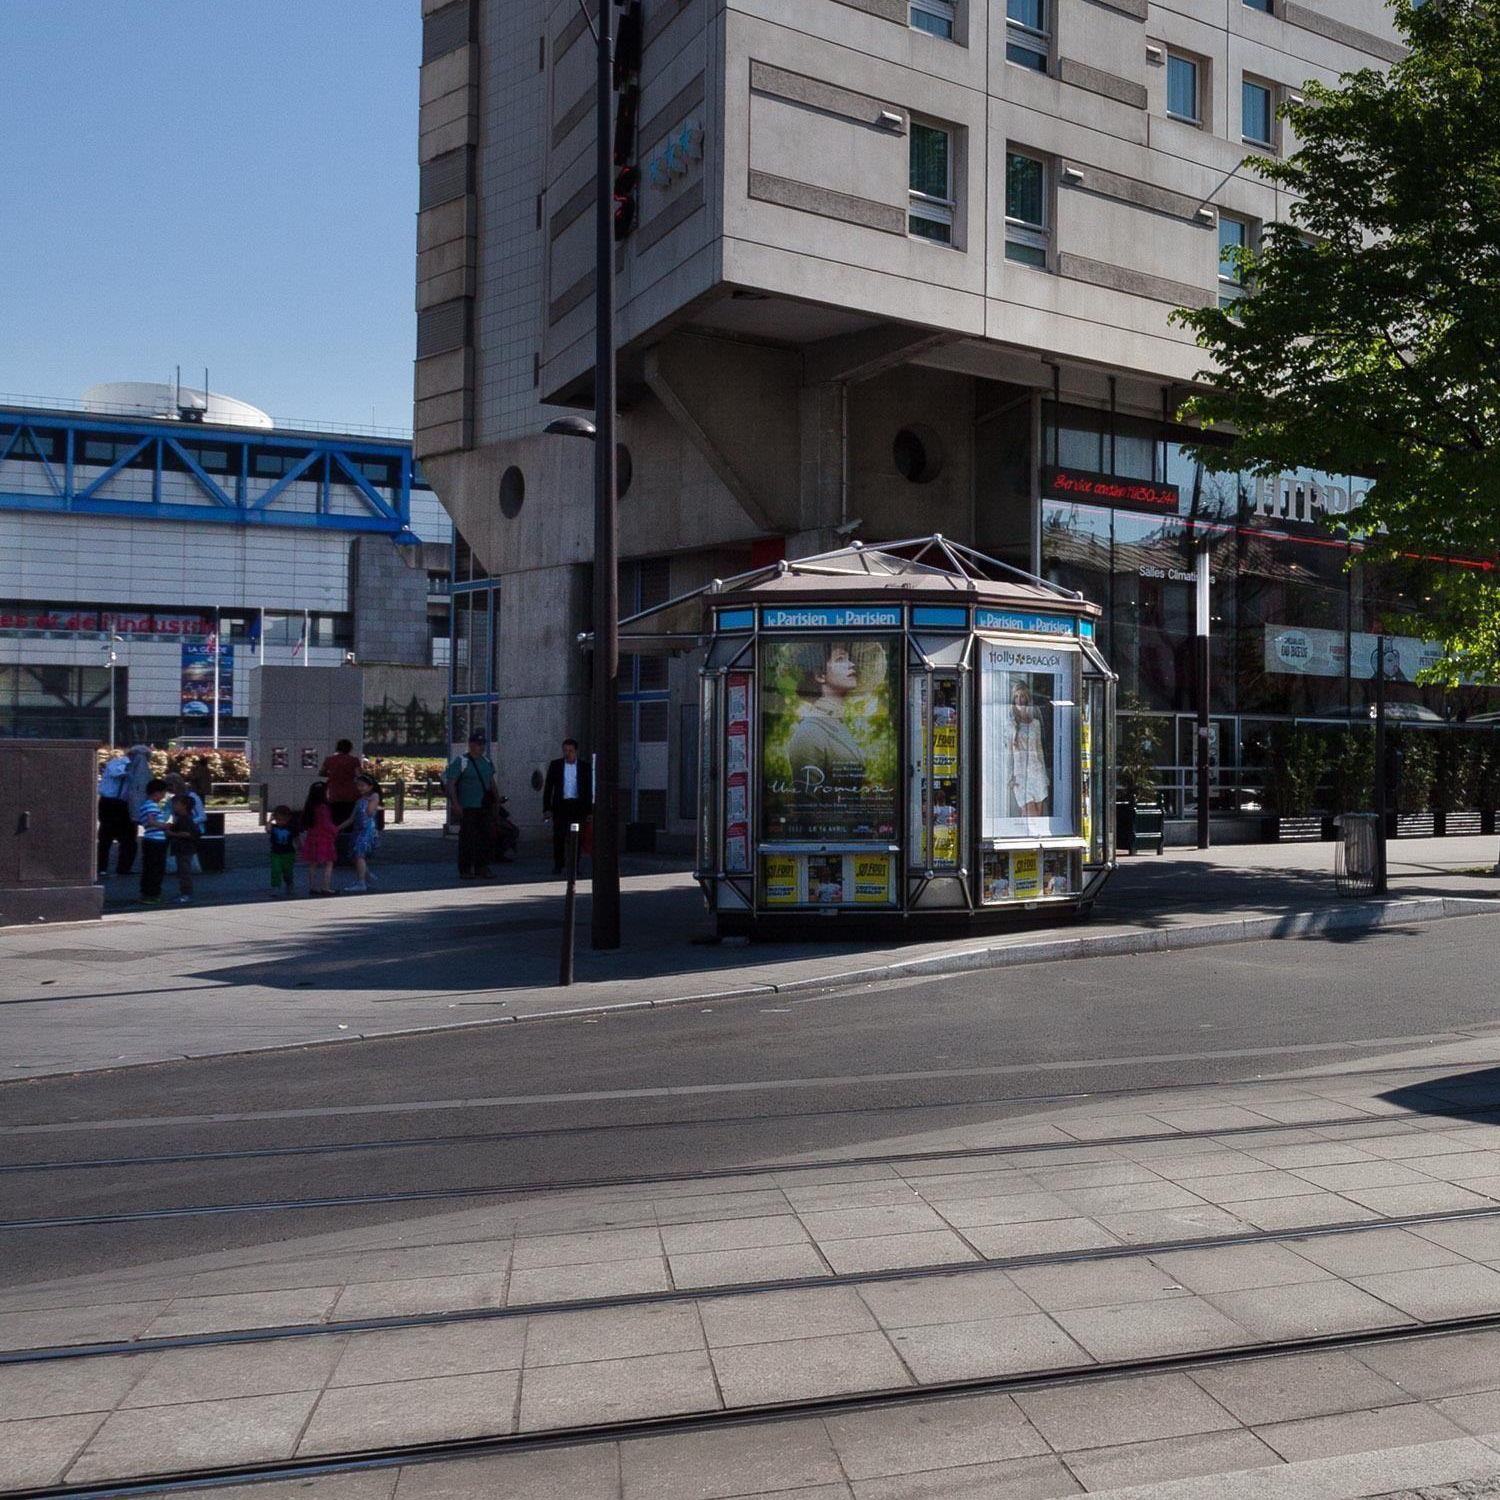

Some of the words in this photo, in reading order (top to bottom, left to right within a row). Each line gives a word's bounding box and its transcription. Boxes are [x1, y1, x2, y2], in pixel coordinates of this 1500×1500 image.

[1139, 565, 1165, 579] Salles
[34, 613, 57, 630] et
[66, 612, 96, 631] de
[777, 611, 828, 626] Parisien
[845, 610, 896, 625] Parisien
[986, 613, 1024, 631] Parisien
[1036, 617, 1070, 634] Parisien
